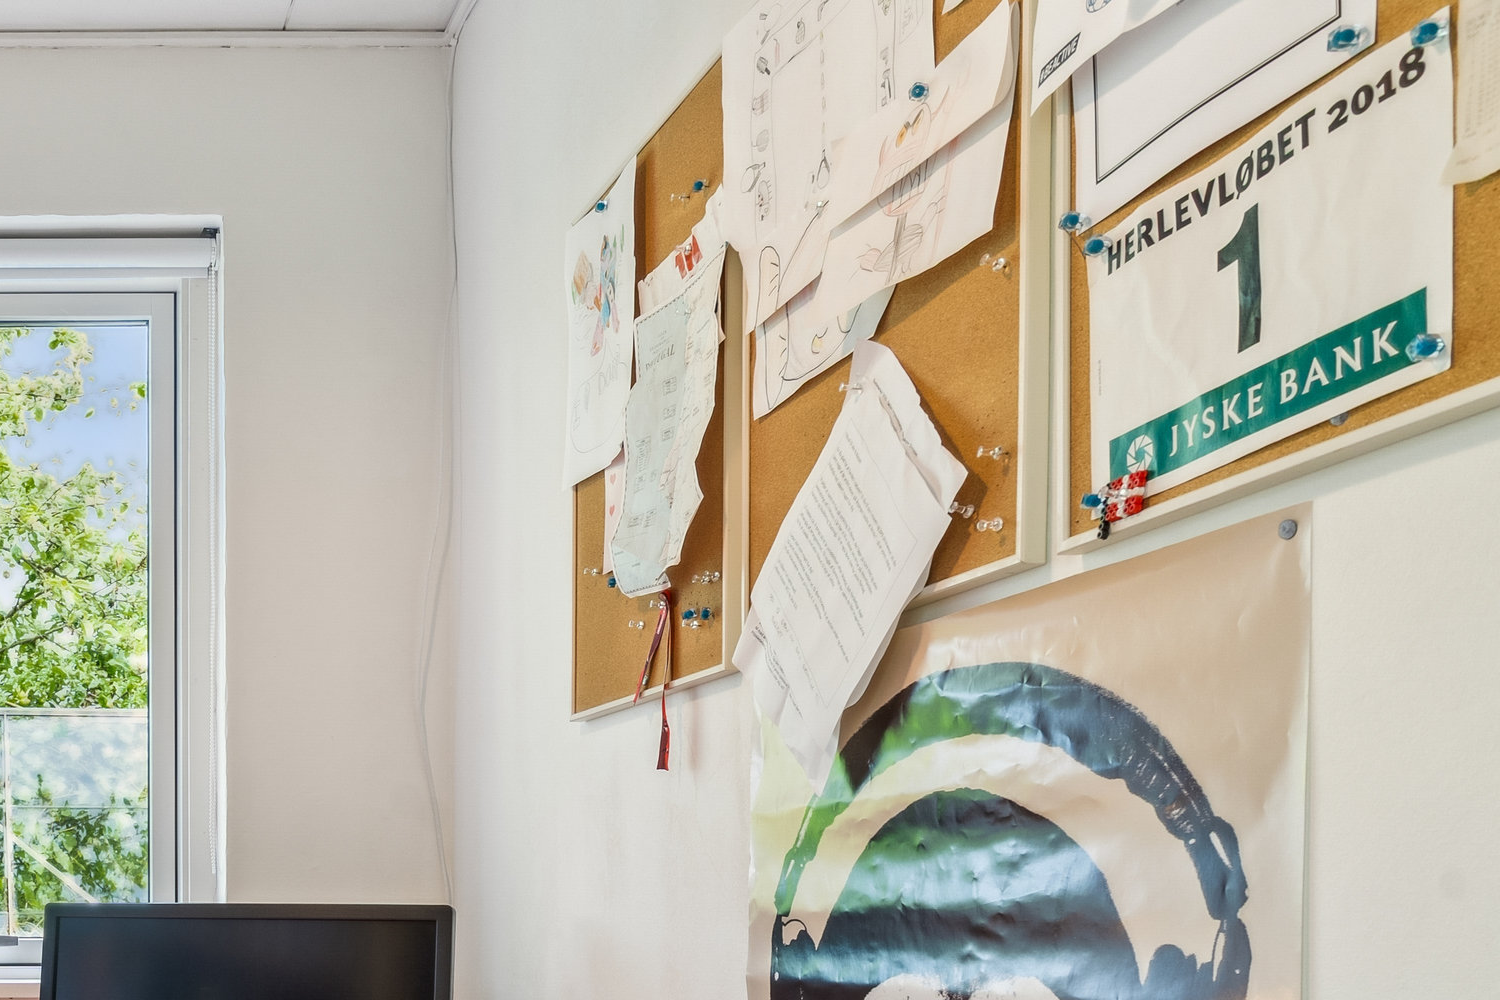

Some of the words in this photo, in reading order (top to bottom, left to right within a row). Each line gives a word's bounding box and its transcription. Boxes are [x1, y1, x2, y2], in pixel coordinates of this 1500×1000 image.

[1040, 36, 1079, 82] #BEACTIVE
[1106, 108, 1317, 276] HERLEVLØBET
[1326, 46, 1427, 134] 2018
[1216, 202, 1263, 355] 1
[1168, 382, 1264, 458] JYSKE
[1279, 320, 1399, 405] BANK
